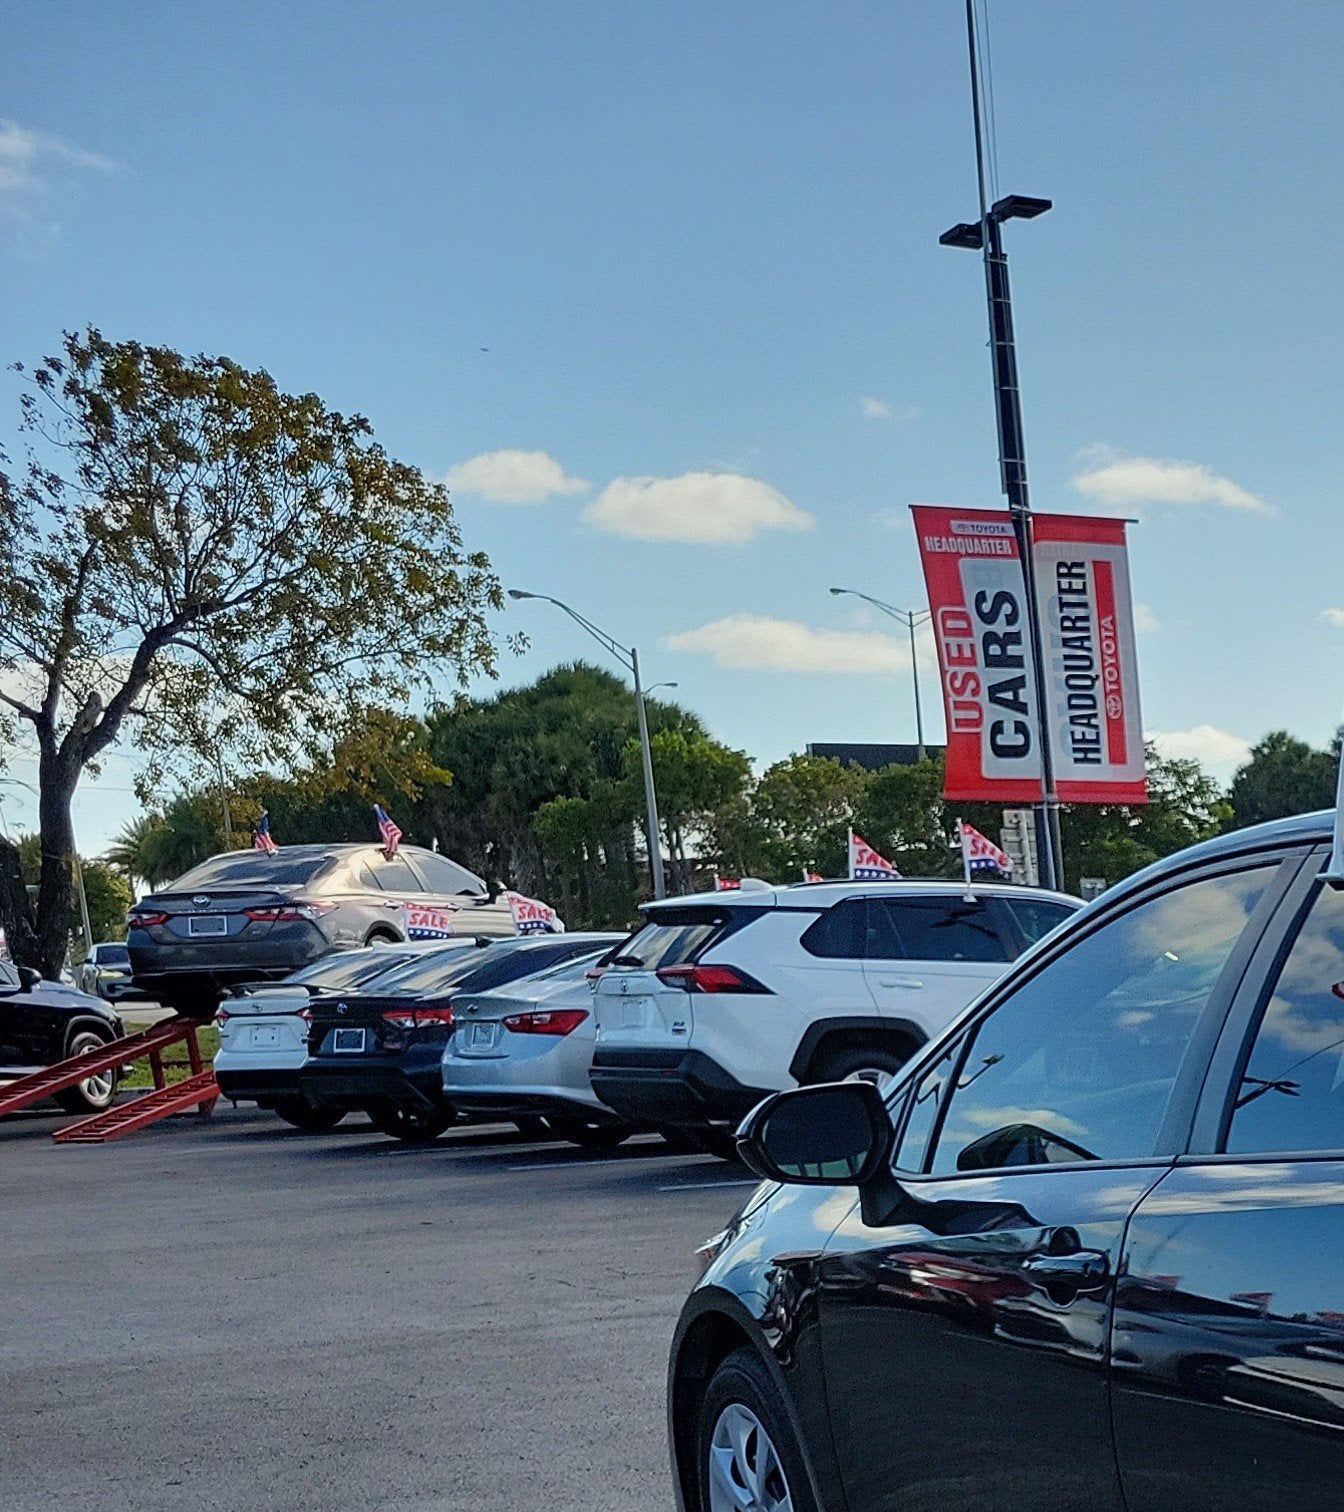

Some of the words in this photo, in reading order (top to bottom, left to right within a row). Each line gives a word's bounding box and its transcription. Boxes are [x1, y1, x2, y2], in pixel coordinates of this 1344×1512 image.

[924, 535, 1012, 554] HEADQUARTER
[970, 524, 1008, 534] TOYOTA
[939, 607, 985, 732] USED
[974, 589, 1031, 759] CARS
[1056, 560, 1102, 765] HEADQUARTER
[1100, 615, 1119, 691] TOYOTA
[409, 912, 449, 929] SALE
